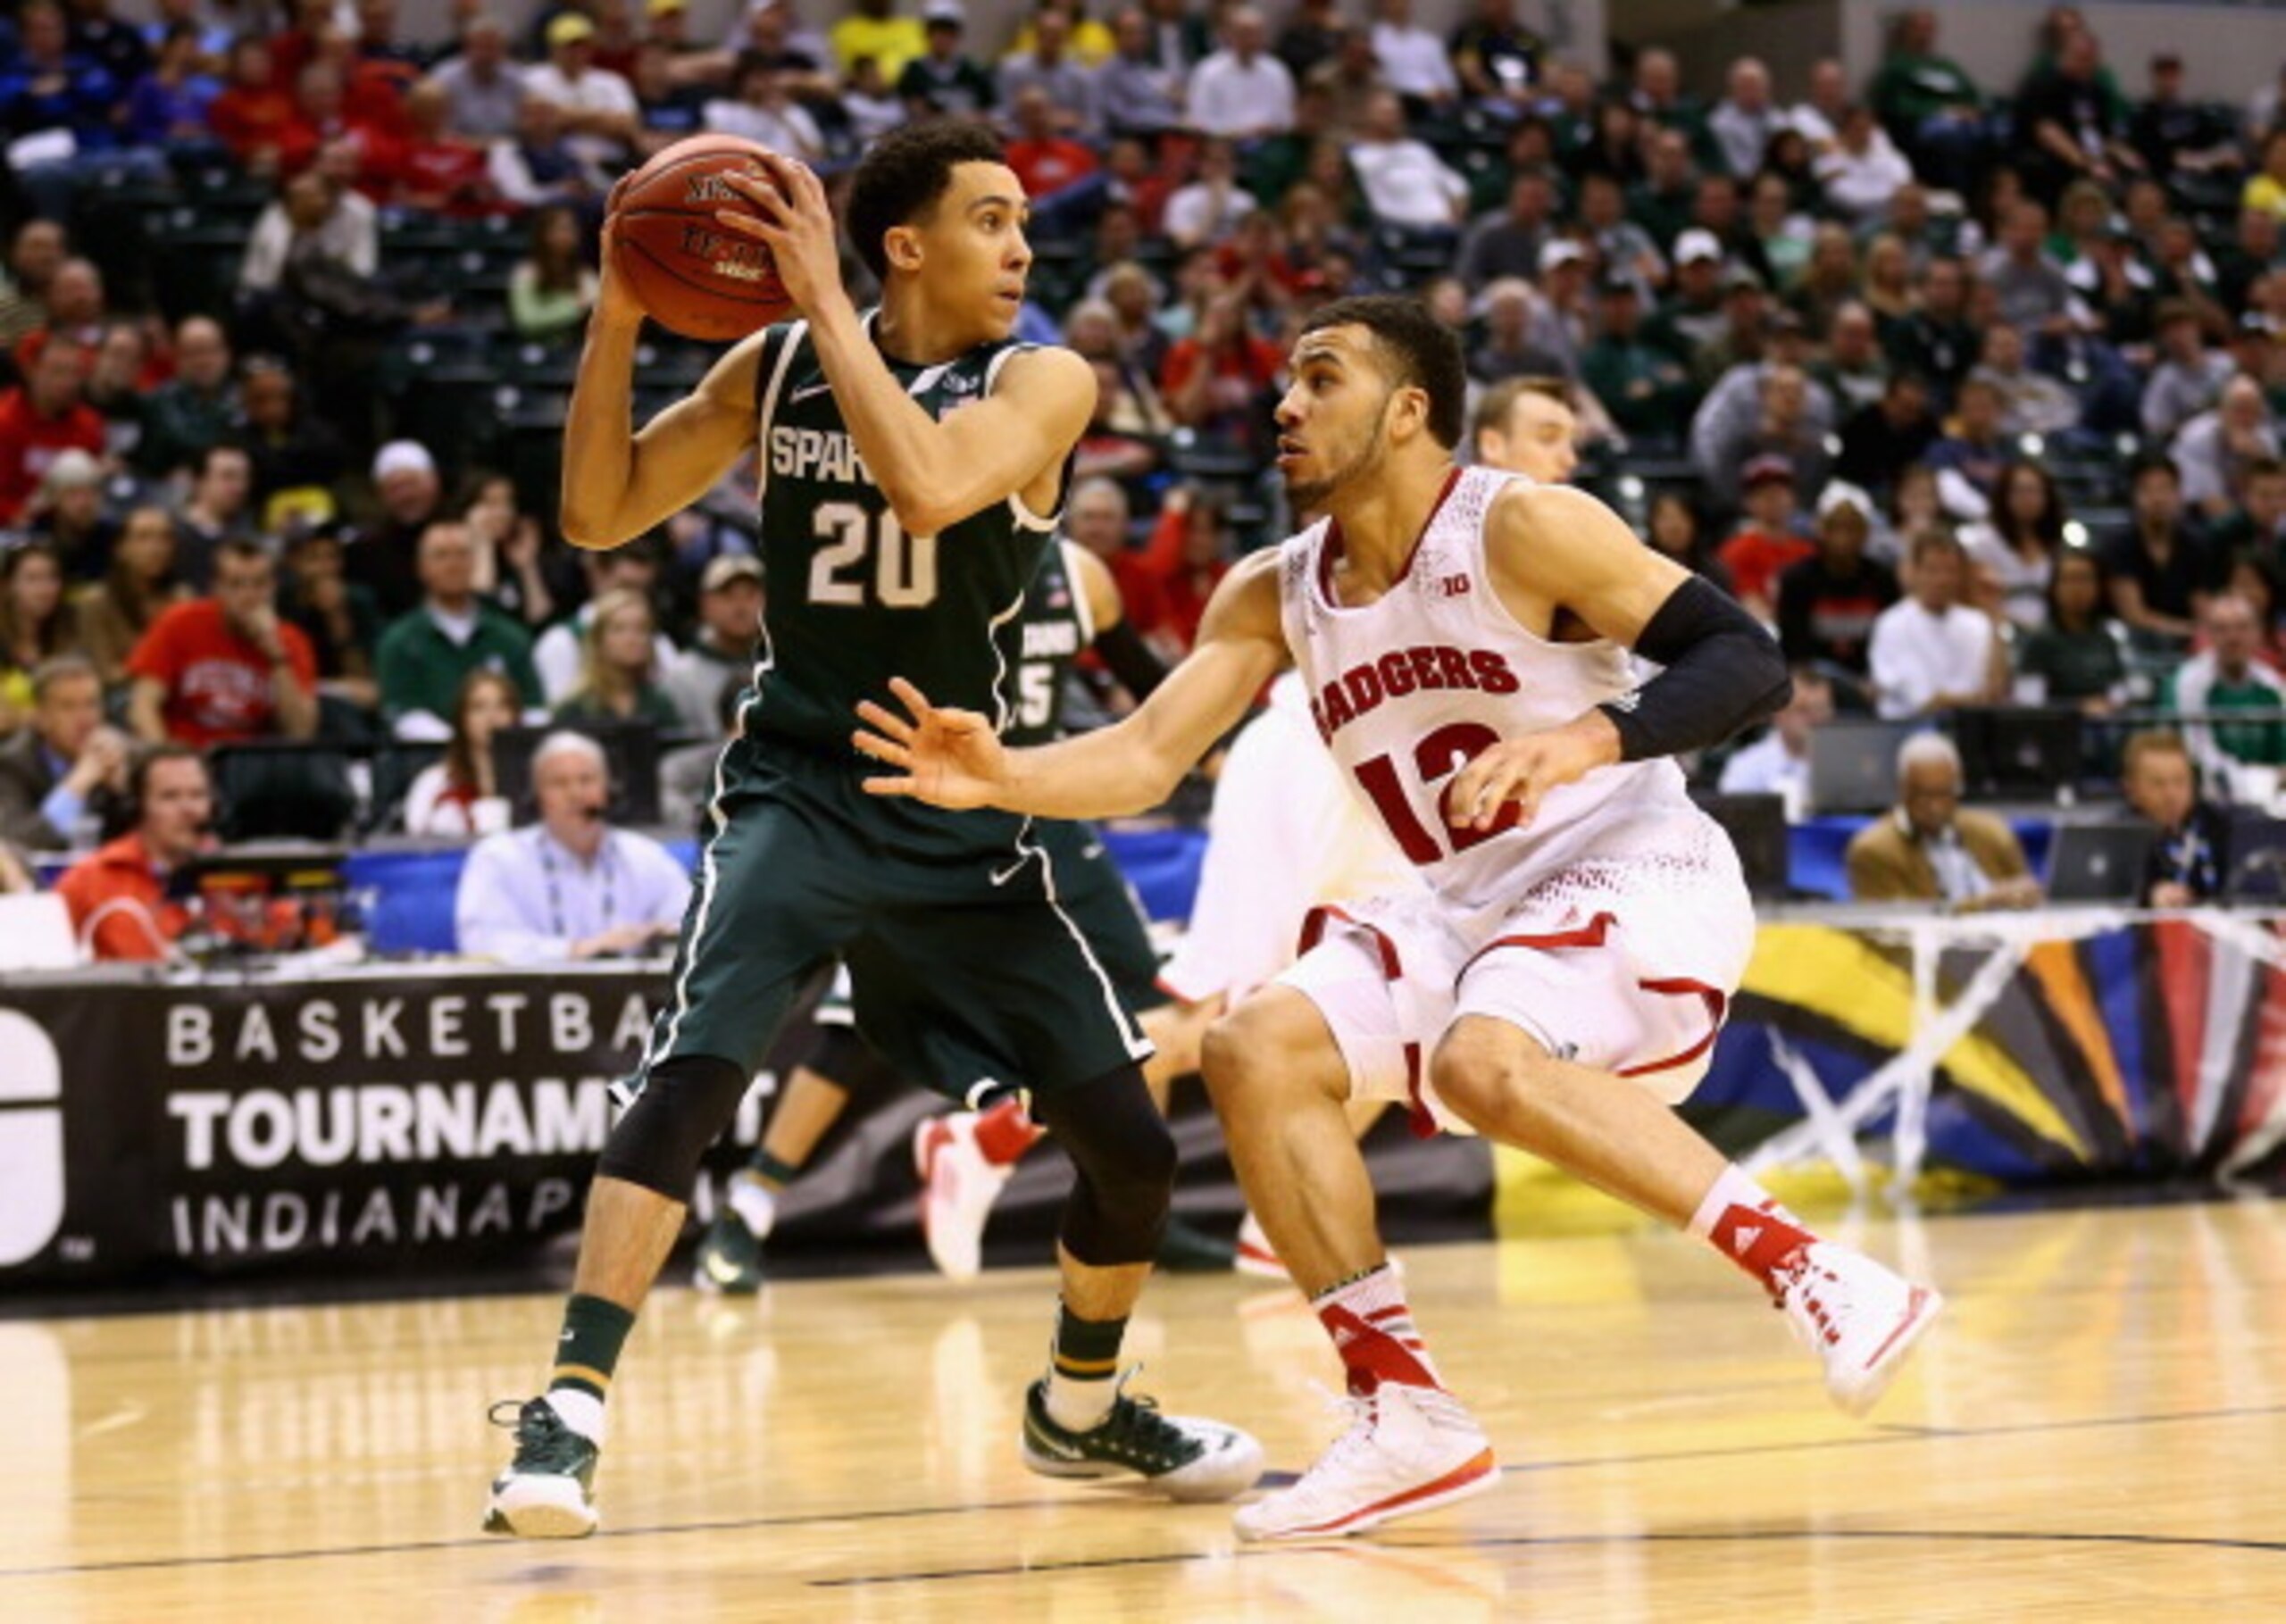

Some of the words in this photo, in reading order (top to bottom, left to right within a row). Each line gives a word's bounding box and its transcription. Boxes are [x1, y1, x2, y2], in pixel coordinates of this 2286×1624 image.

[772, 426, 877, 484] SPAR
[808, 501, 937, 606] 20
[1354, 721, 1522, 865] 12
[168, 991, 655, 1066] BASKETBA
